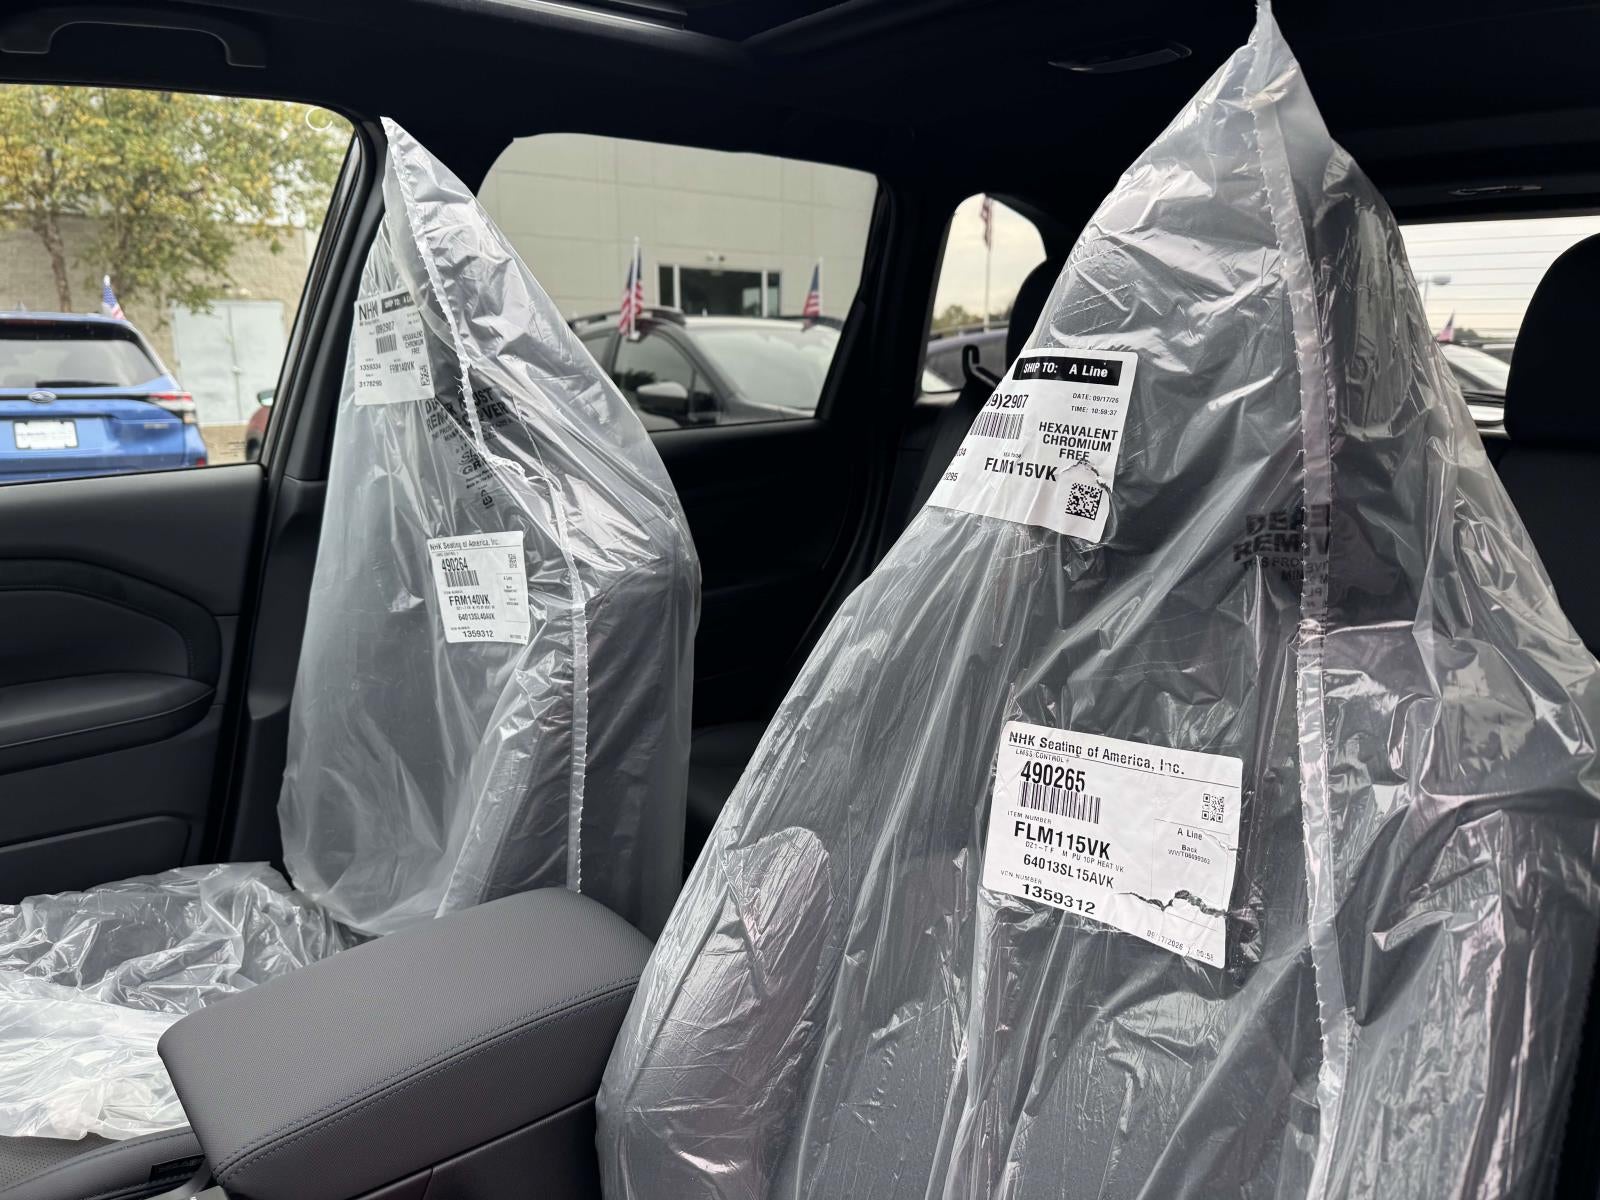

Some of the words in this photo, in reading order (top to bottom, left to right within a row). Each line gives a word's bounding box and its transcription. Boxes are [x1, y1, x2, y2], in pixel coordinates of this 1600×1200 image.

[1023, 362, 1040, 374] SHIP
[1042, 362, 1058, 373] TO:
[1068, 364, 1078, 375] A
[1082, 365, 1108, 378] Line
[1071, 405, 1088, 413] TIME:
[1039, 421, 1118, 440] HEXAVALENT
[1043, 433, 1112, 452] CHROMIUM
[1059, 448, 1090, 461] FREE
[984, 457, 1058, 481] FLM115VK
[442, 557, 468, 571] 490264
[463, 630, 494, 638] 1359312
[1008, 731, 1036, 746] NHK
[1040, 737, 1082, 758] Seating
[1088, 746, 1099, 758] of
[1103, 748, 1155, 771] America,
[1160, 758, 1185, 775] Inc.
[1020, 760, 1086, 793] 490265
[1007, 810, 1023, 819] ITEM
[1024, 814, 1052, 825] NUMBER
[1014, 820, 1111, 860] FLM115VK
[1177, 827, 1183, 836] A
[1186, 829, 1203, 841] Line
[1181, 844, 1198, 854] Back
[1072, 852, 1081, 861] PU
[1097, 860, 1114, 869] HEAT
[1015, 873, 1042, 884] NUMBER
[1023, 853, 1114, 888] 64013SL15AVK
[1023, 883, 1096, 915] 1359312
